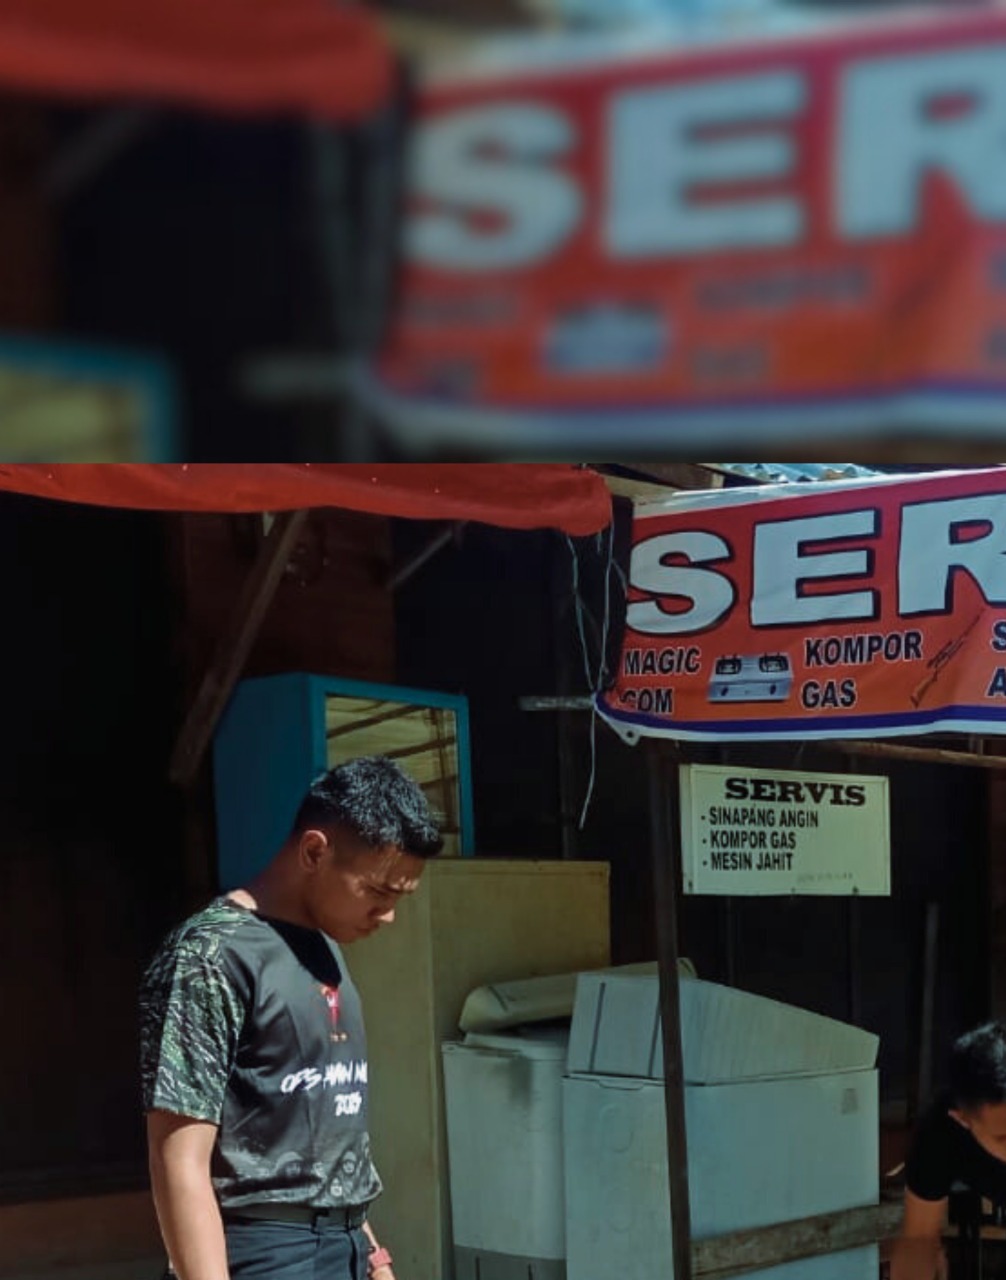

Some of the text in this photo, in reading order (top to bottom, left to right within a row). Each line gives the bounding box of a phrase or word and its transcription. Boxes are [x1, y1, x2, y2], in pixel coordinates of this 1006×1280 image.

[623, 647, 701, 677] MAGIC
[803, 631, 923, 668] KOMPOR
[800, 678, 857, 709] GAS
[724, 777, 866, 807] SERVIS
[709, 806, 819, 829] SINAPANG ANGIN
[709, 830, 797, 850] KOMPOR GAS
[710, 852, 794, 871] MESIN JAHIT
